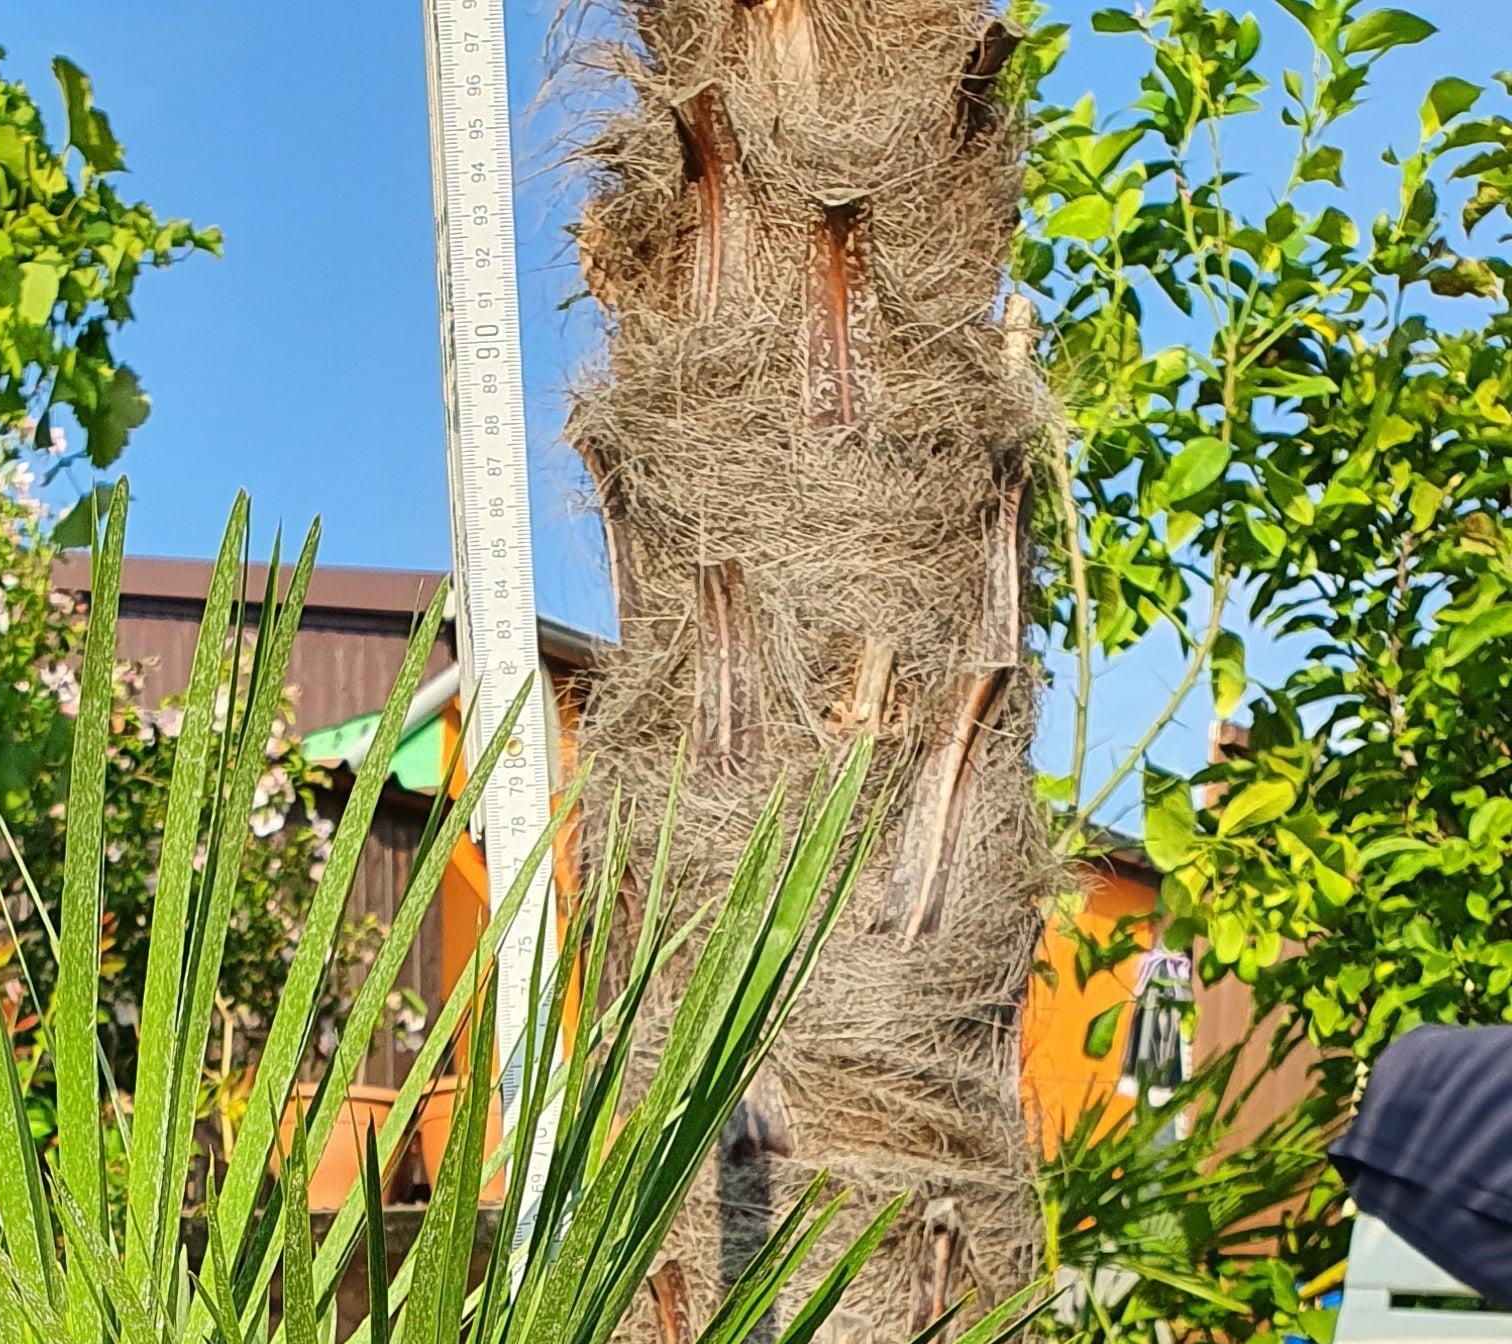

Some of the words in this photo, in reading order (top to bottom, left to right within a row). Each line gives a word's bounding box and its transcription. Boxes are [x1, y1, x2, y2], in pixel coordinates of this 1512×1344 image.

[462, 0, 477, 9] 9
[464, 32, 479, 53] 97
[466, 74, 481, 96] 96
[469, 118, 484, 140] 95
[471, 162, 487, 184] 94
[473, 204, 489, 226] 93
[475, 247, 491, 268] 92
[478, 290, 493, 309] 91
[475, 324, 500, 360] 90
[483, 373, 498, 394] 89
[485, 415, 500, 436] 88
[487, 456, 503, 477] 87
[490, 497, 505, 518] 86
[492, 537, 507, 558] 85
[495, 578, 510, 599] 84
[497, 620, 512, 640] 83
[509, 776, 525, 797] 79
[512, 816, 527, 836] 78
[518, 936, 532, 956] 75
